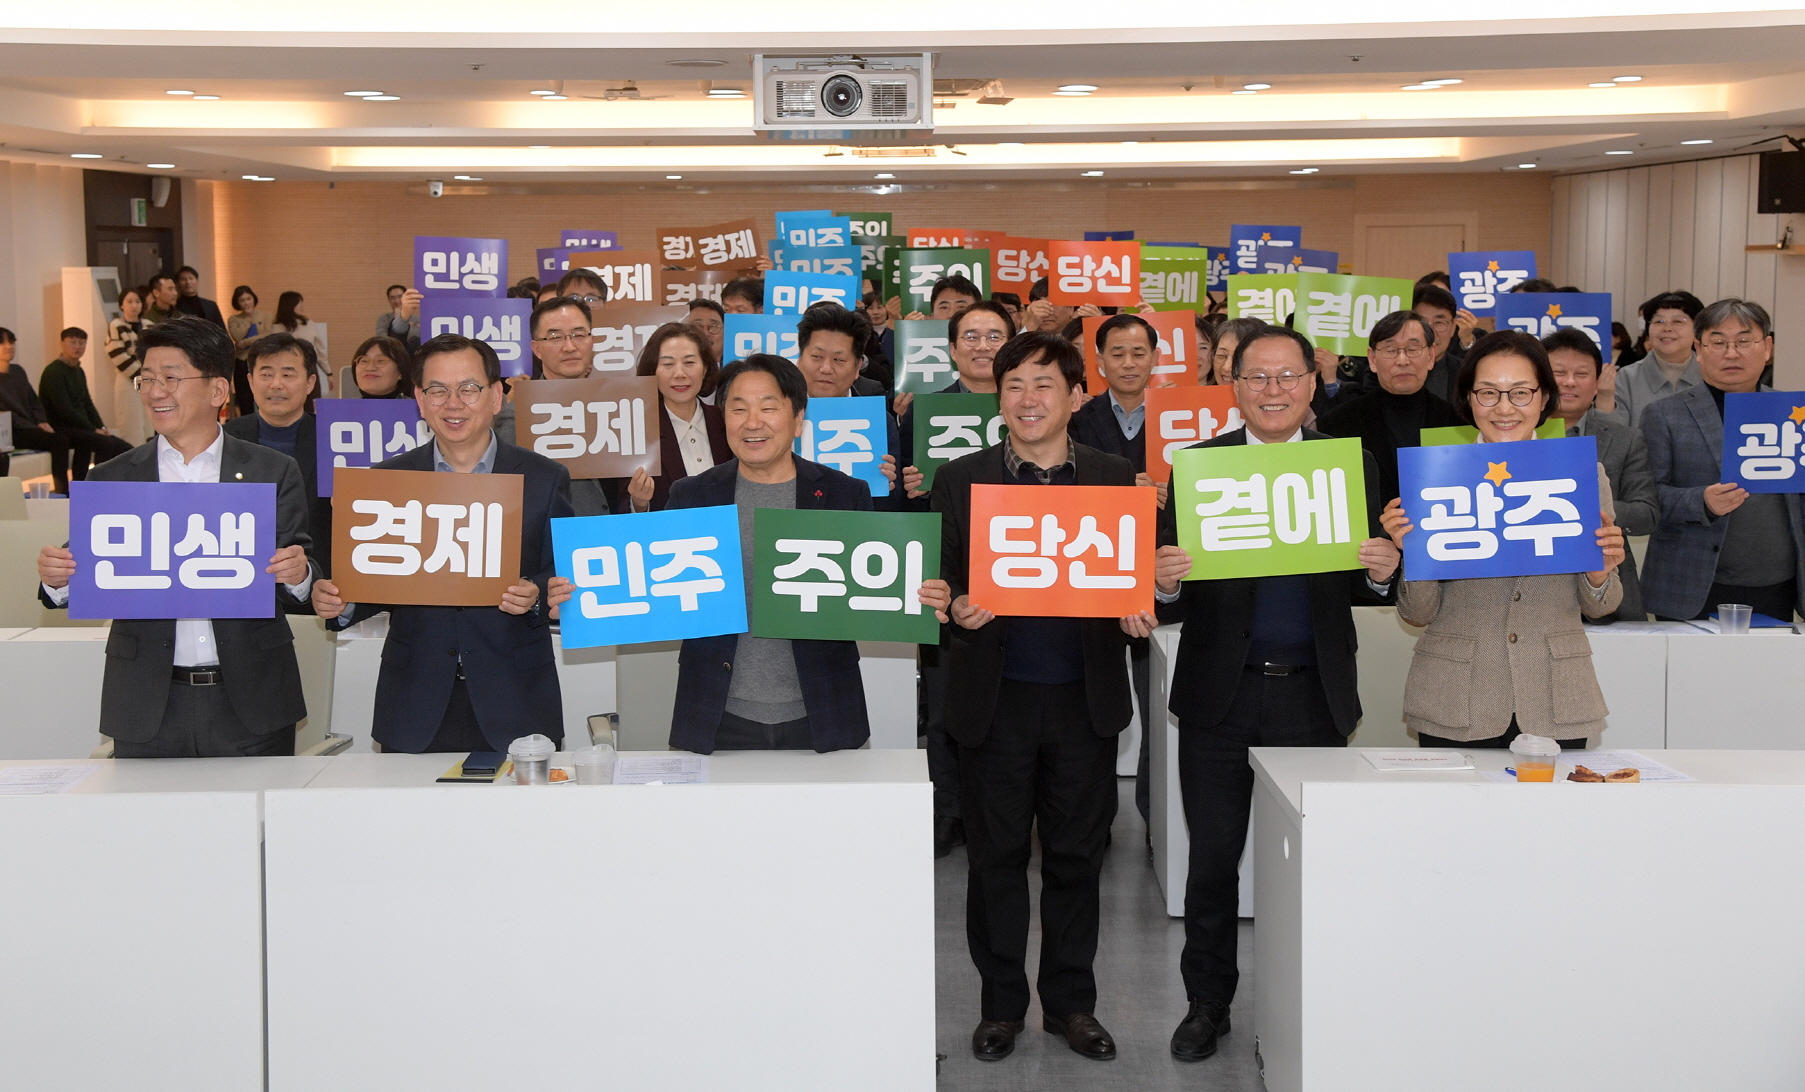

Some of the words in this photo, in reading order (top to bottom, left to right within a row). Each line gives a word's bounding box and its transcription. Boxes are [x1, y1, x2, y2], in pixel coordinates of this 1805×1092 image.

[423, 251, 499, 290] 민생
[698, 228, 757, 265] 경제
[1057, 254, 1131, 293] 당신
[1236, 239, 1293, 268] 광
[1140, 271, 1198, 304] 곁에
[1306, 291, 1401, 338] 곁에
[906, 337, 960, 382] 주
[530, 398, 647, 459] 경제
[791, 419, 874, 476] 주
[927, 415, 1006, 462] 주
[1737, 421, 1805, 480] 광
[350, 499, 503, 578] 경제
[1195, 467, 1351, 552] 곁에
[1420, 478, 1583, 562] 광주
[91, 511, 256, 589] 민생
[571, 536, 725, 619] 민주
[771, 538, 923, 616] 주의
[989, 513, 1136, 589] 당신
